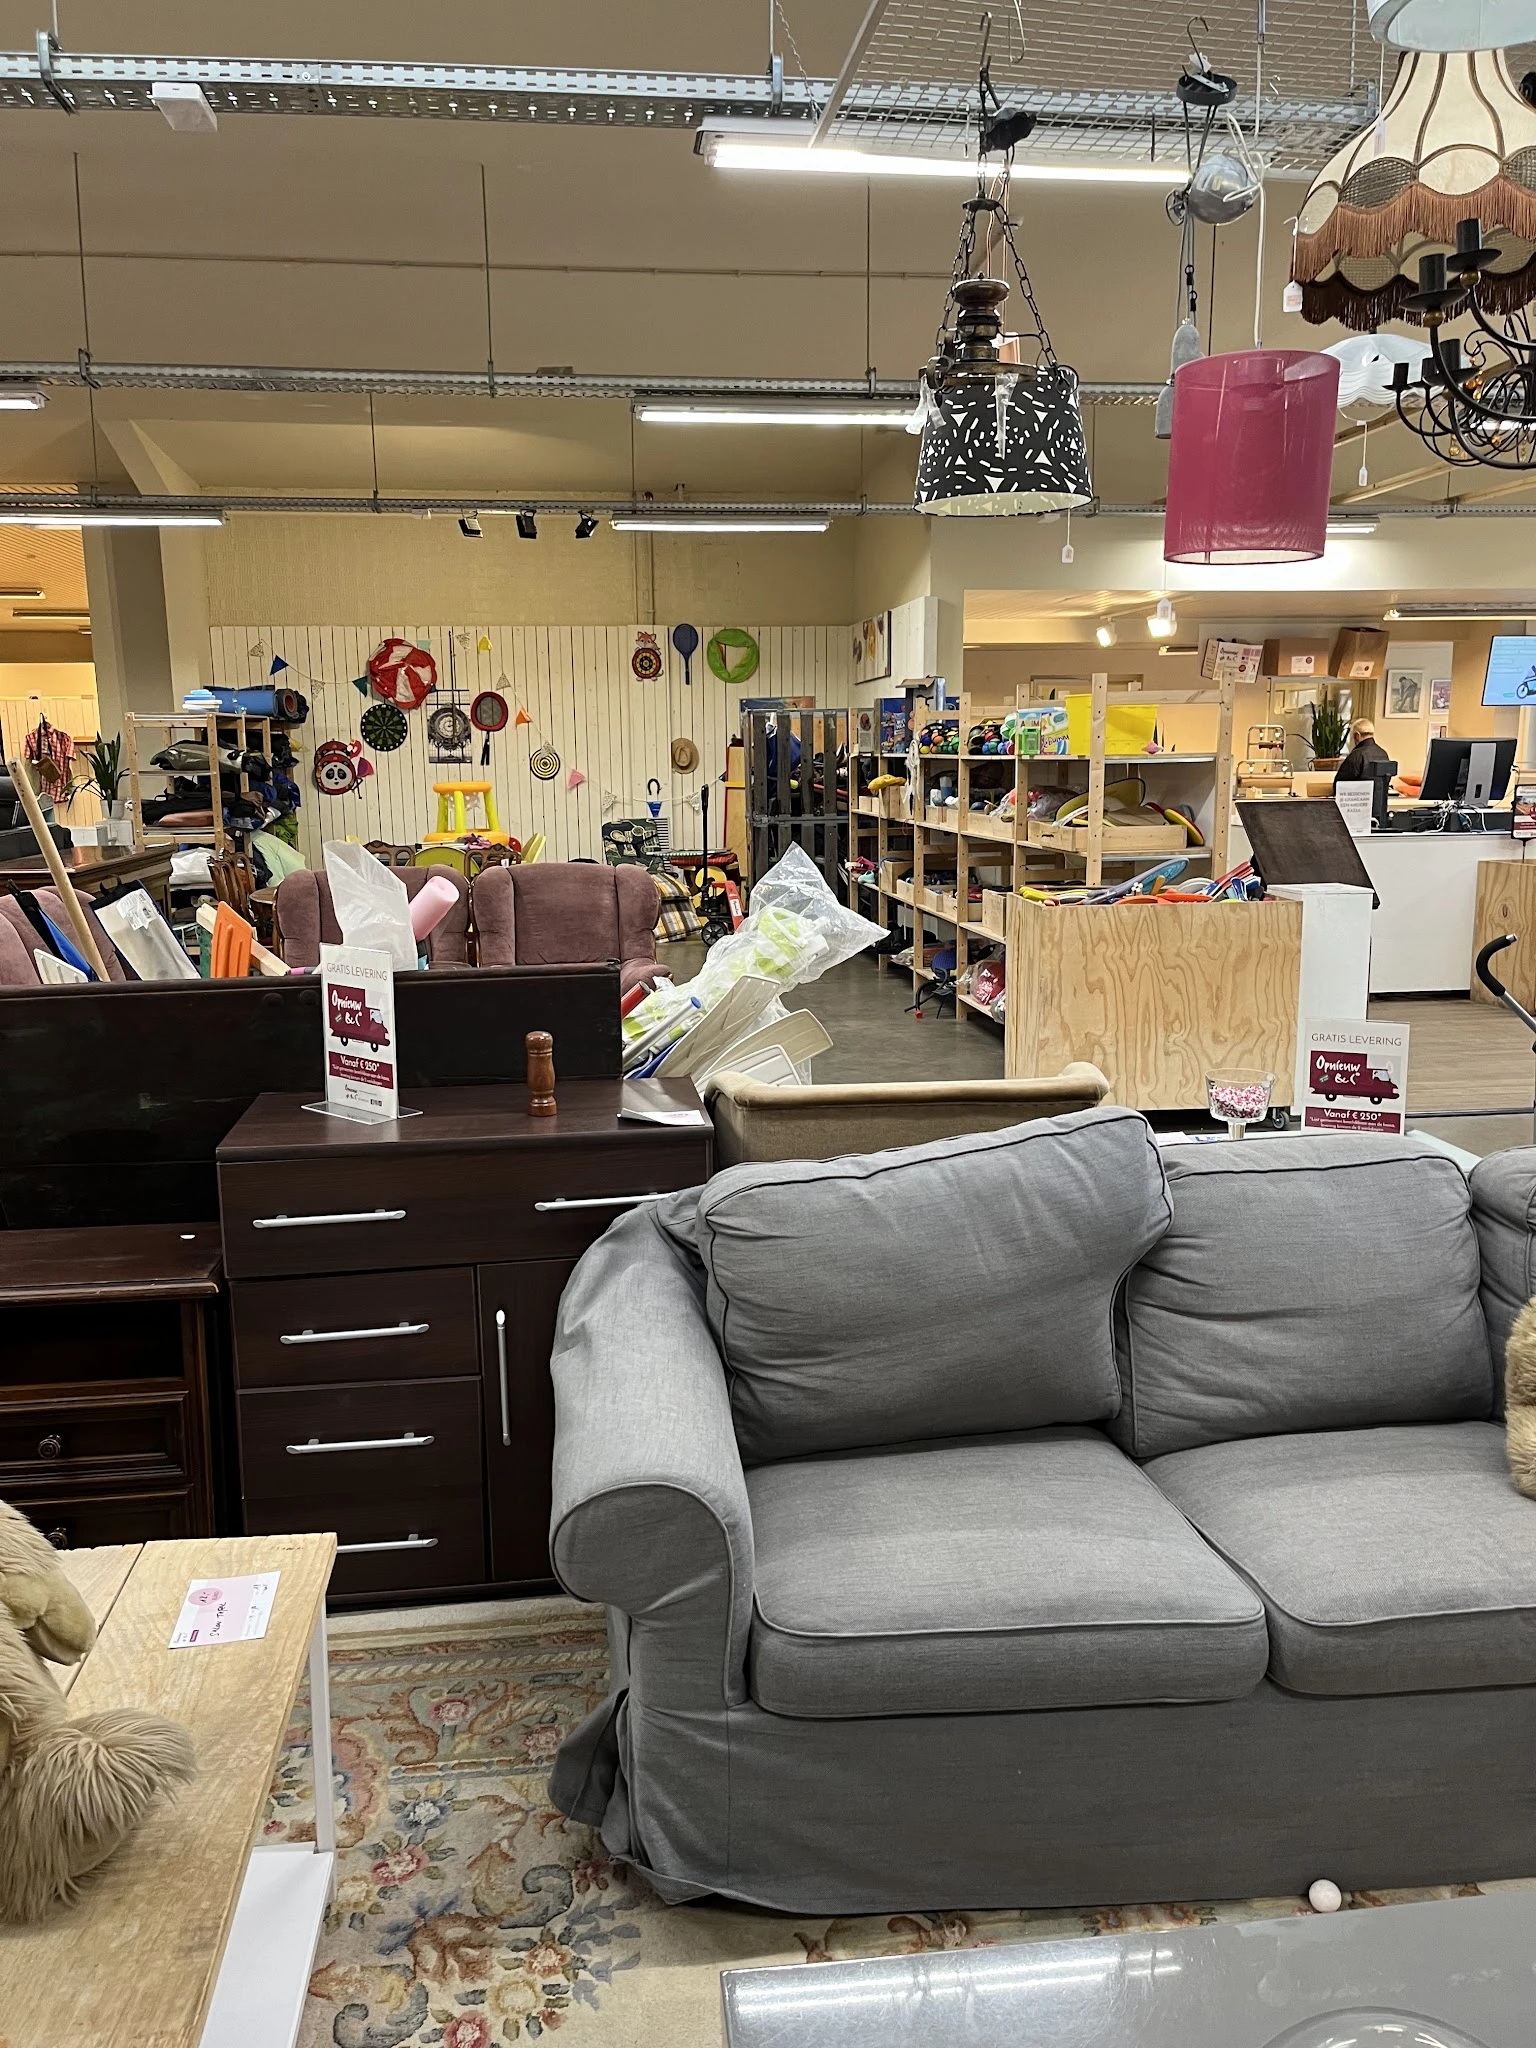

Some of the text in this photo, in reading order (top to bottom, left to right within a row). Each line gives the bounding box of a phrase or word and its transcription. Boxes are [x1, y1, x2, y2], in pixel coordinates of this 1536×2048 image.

[326, 962, 388, 981] GRATIS LEVERING
[331, 989, 362, 1011] Opnieuw
[1311, 1033, 1402, 1047] GRATIS LEVERING
[340, 1054, 360, 1068] Vanaf
[359, 1060, 365, 1069] €
[1316, 1054, 1361, 1073] Opnieuw
[1323, 1108, 1351, 1119] Vanaf
[1352, 1111, 1358, 1120] €
